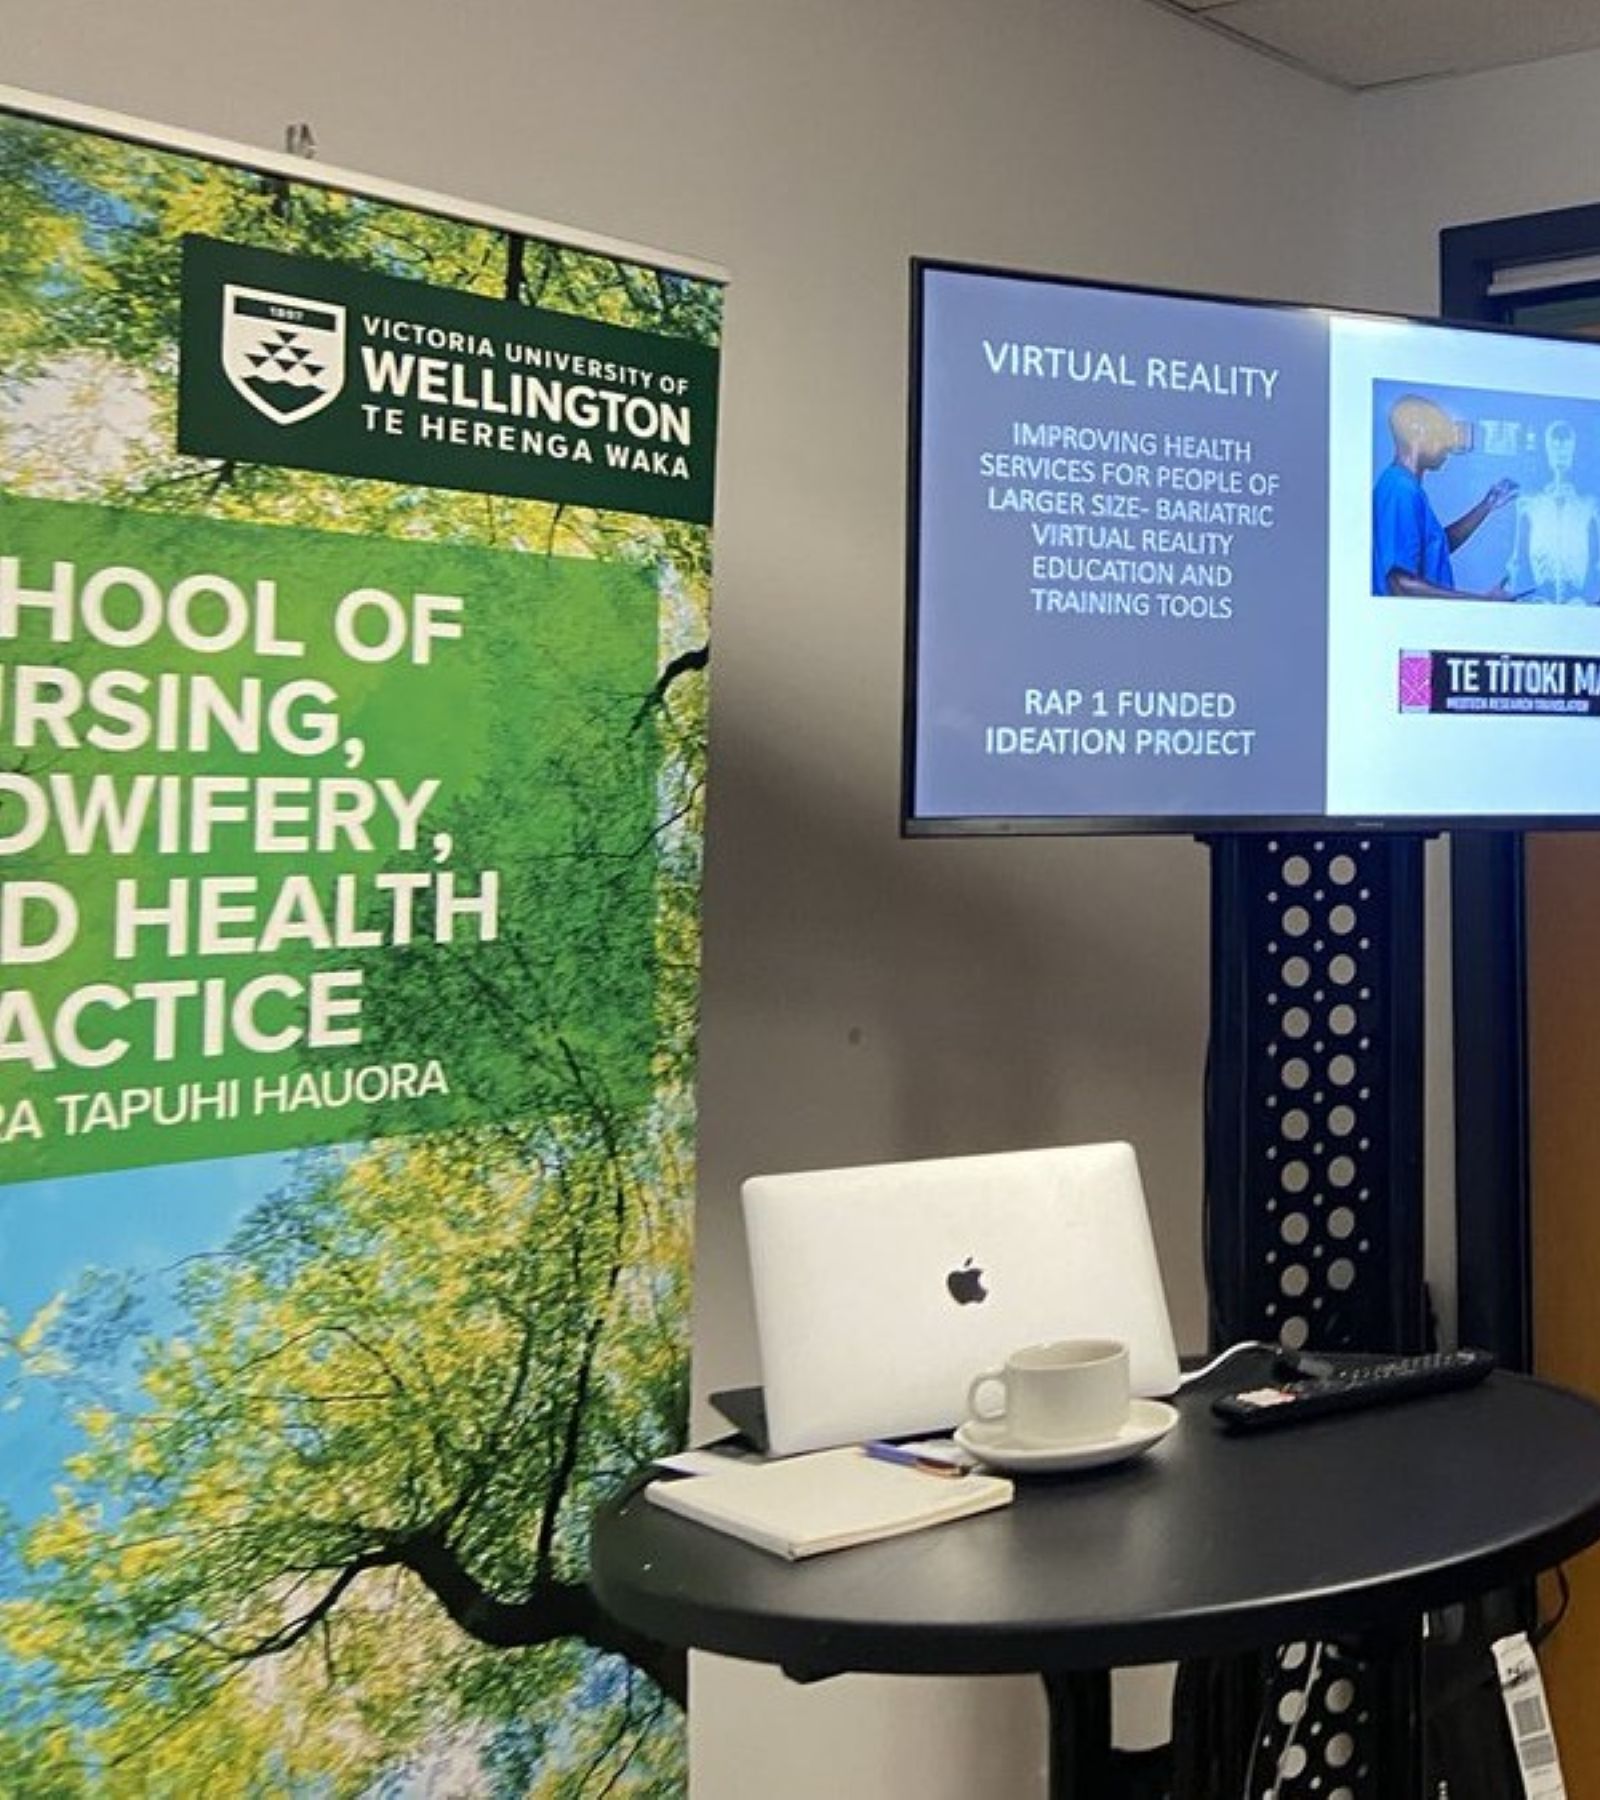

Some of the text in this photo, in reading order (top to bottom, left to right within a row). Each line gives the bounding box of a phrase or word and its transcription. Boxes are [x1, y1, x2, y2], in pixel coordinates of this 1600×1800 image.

[362, 315, 689, 396] VICTORIA UNIVERSITY OF
[982, 340, 1279, 399] VIRTUAL REALITY
[361, 345, 691, 446] WELLINGTON
[361, 404, 690, 480] TE HERENGA WAKA
[1013, 422, 1251, 463] IMPROVING HEALTH
[980, 453, 1280, 496] SERVICES FOR PEOPLE OF
[988, 487, 1273, 528] LARGER SIZE- BARIATRIC
[1032, 523, 1235, 556] VIRTUAL REALITY
[1033, 556, 1232, 587] EDUCATION AND
[0, 556, 464, 665] HOOL OF
[1031, 588, 1233, 619] TRAINING TOOLS
[1447, 659, 1479, 692] TE
[0, 664, 365, 768] RSING,
[1025, 689, 1236, 718] RAP 1 FUNDED
[985, 726, 1256, 757] IDEATION PROJECT
[114, 870, 499, 960] HEALTH
[0, 1060, 449, 1142] A TAPUHI HAUORA
